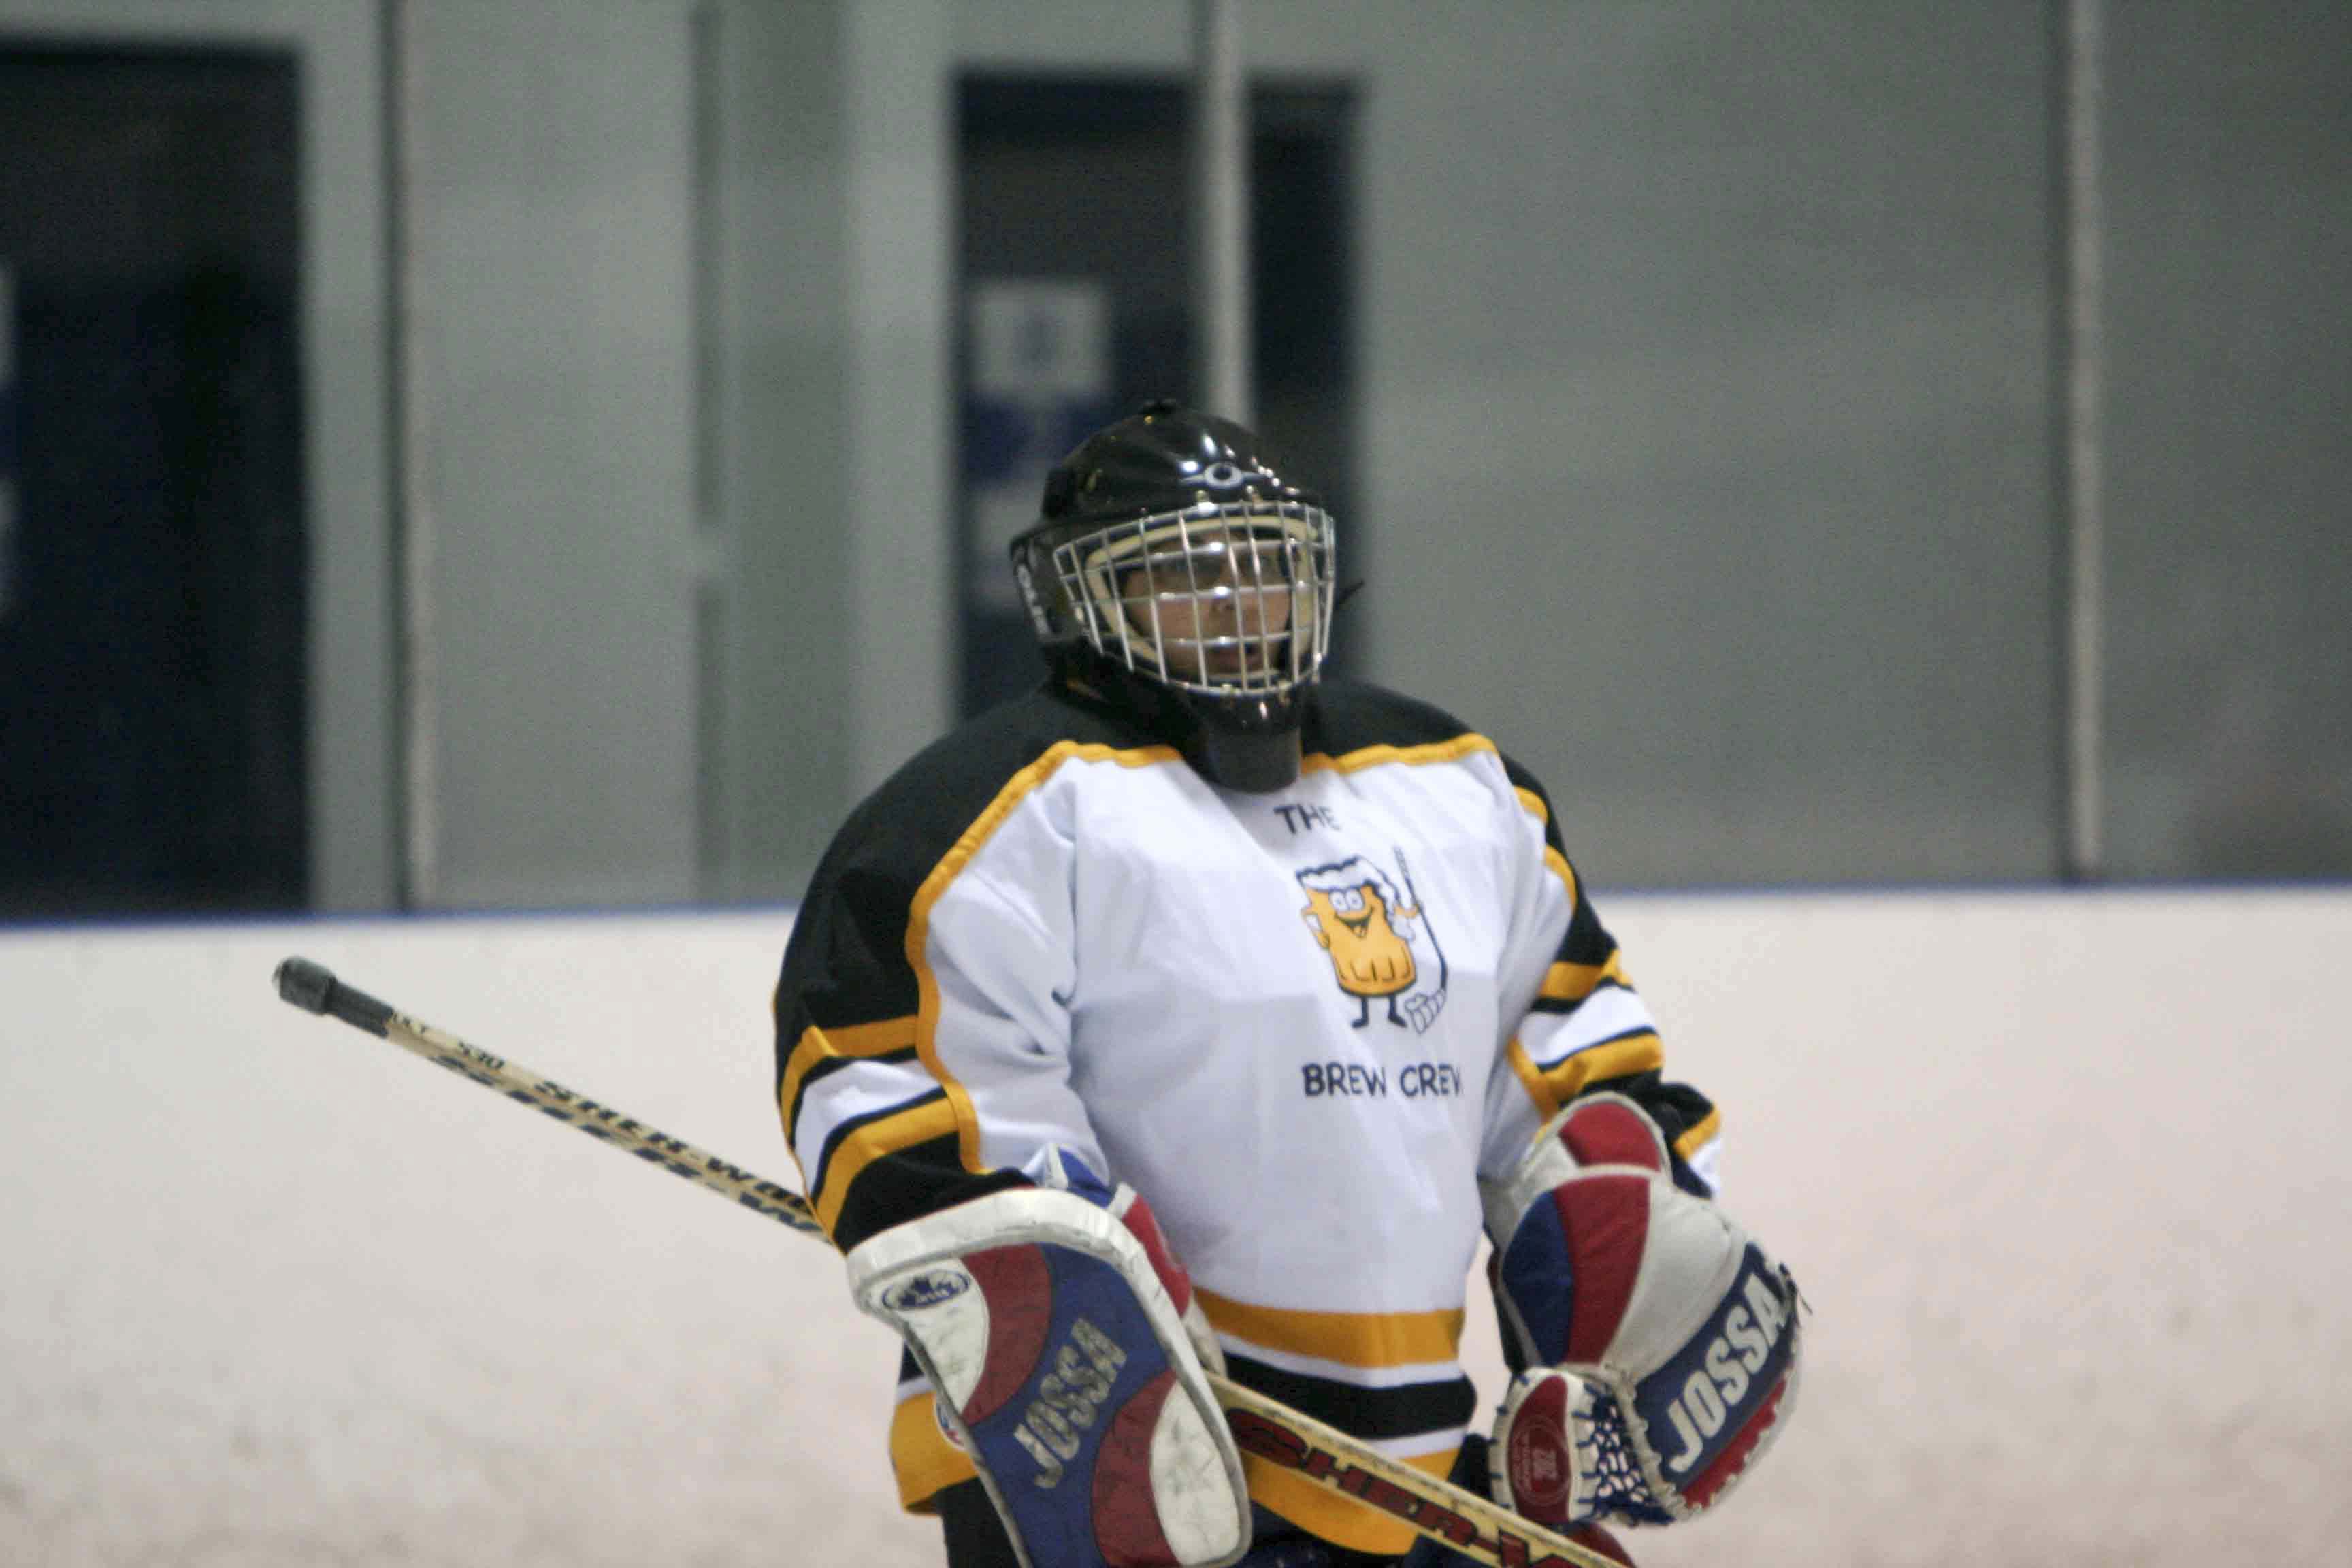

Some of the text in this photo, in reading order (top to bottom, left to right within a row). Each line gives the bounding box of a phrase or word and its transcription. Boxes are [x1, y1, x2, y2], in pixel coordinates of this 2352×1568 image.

[1273, 804, 1341, 834] THE
[1301, 1062, 1387, 1097] BREW
[1014, 1317, 1127, 1489] JOSSA
[1668, 1273, 1784, 1473] JOSSA
